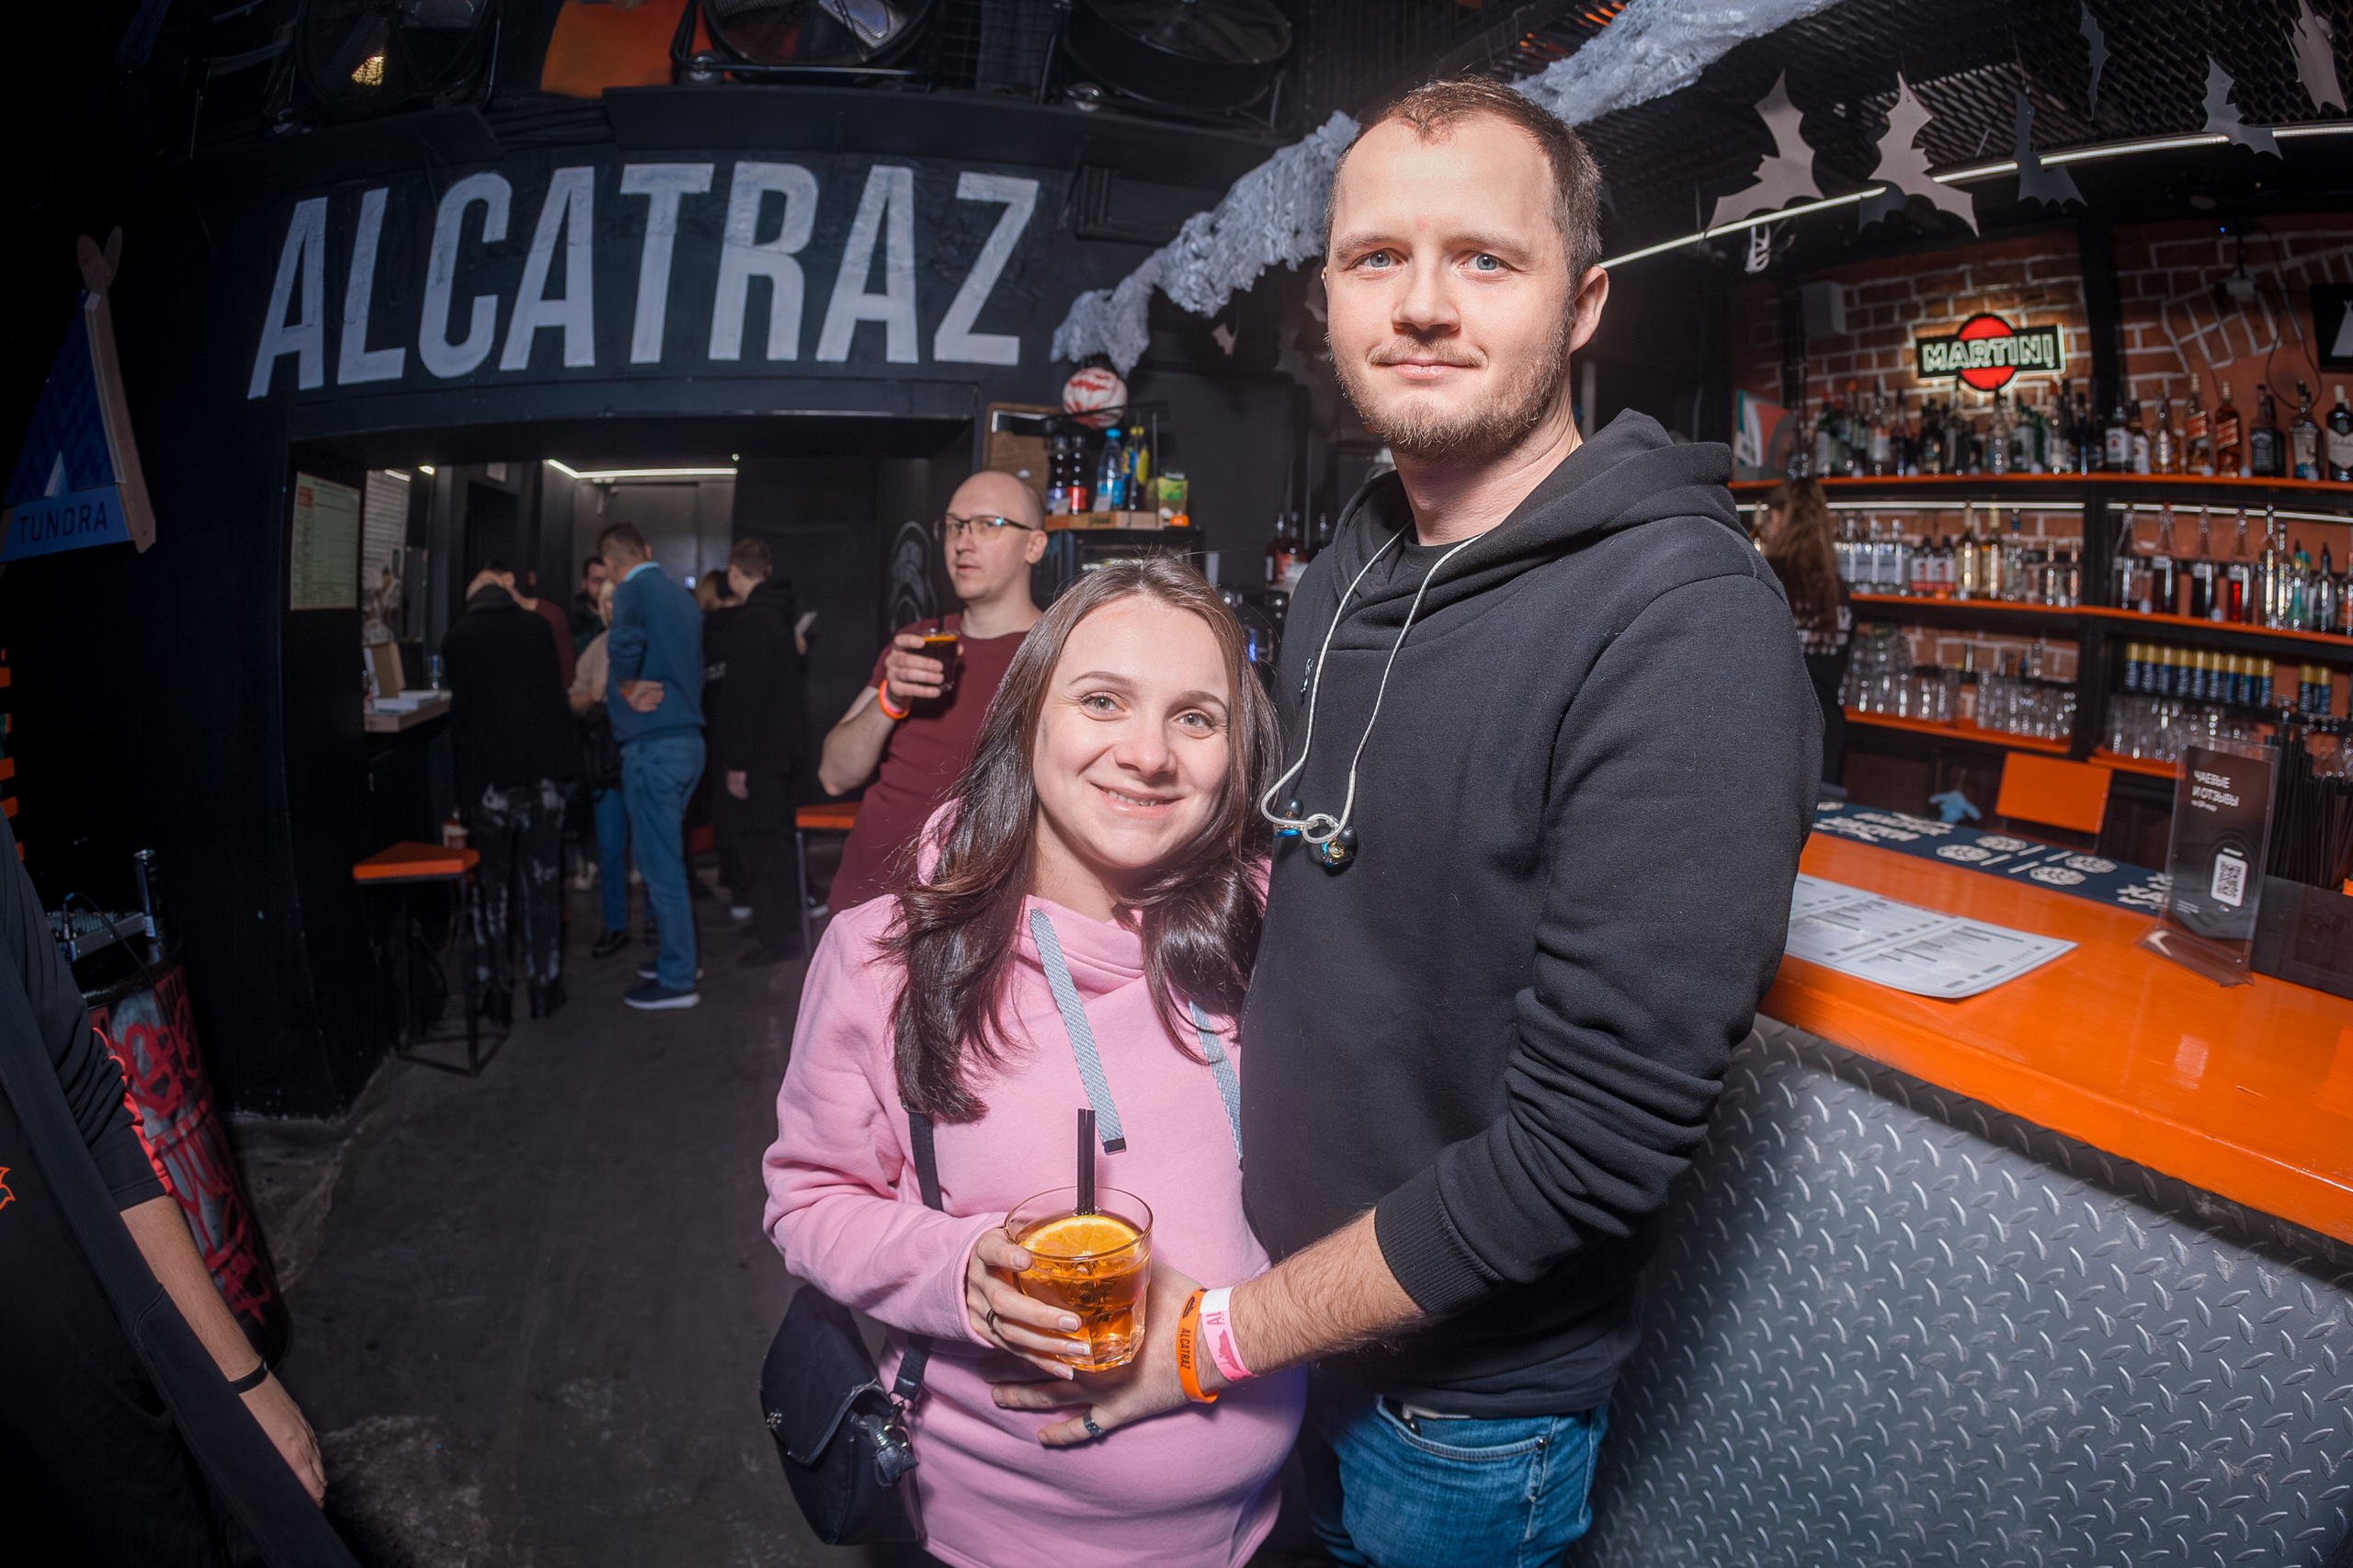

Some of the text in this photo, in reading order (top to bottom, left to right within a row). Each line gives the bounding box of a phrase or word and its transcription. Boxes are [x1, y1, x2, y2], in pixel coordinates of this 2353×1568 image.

[246, 160, 1040, 400] ALCATRAZ
[1921, 333, 2056, 372] MARTINI
[18, 501, 108, 544] TUNDRA
[1179, 1327, 1192, 1369] ALCATRAZ
